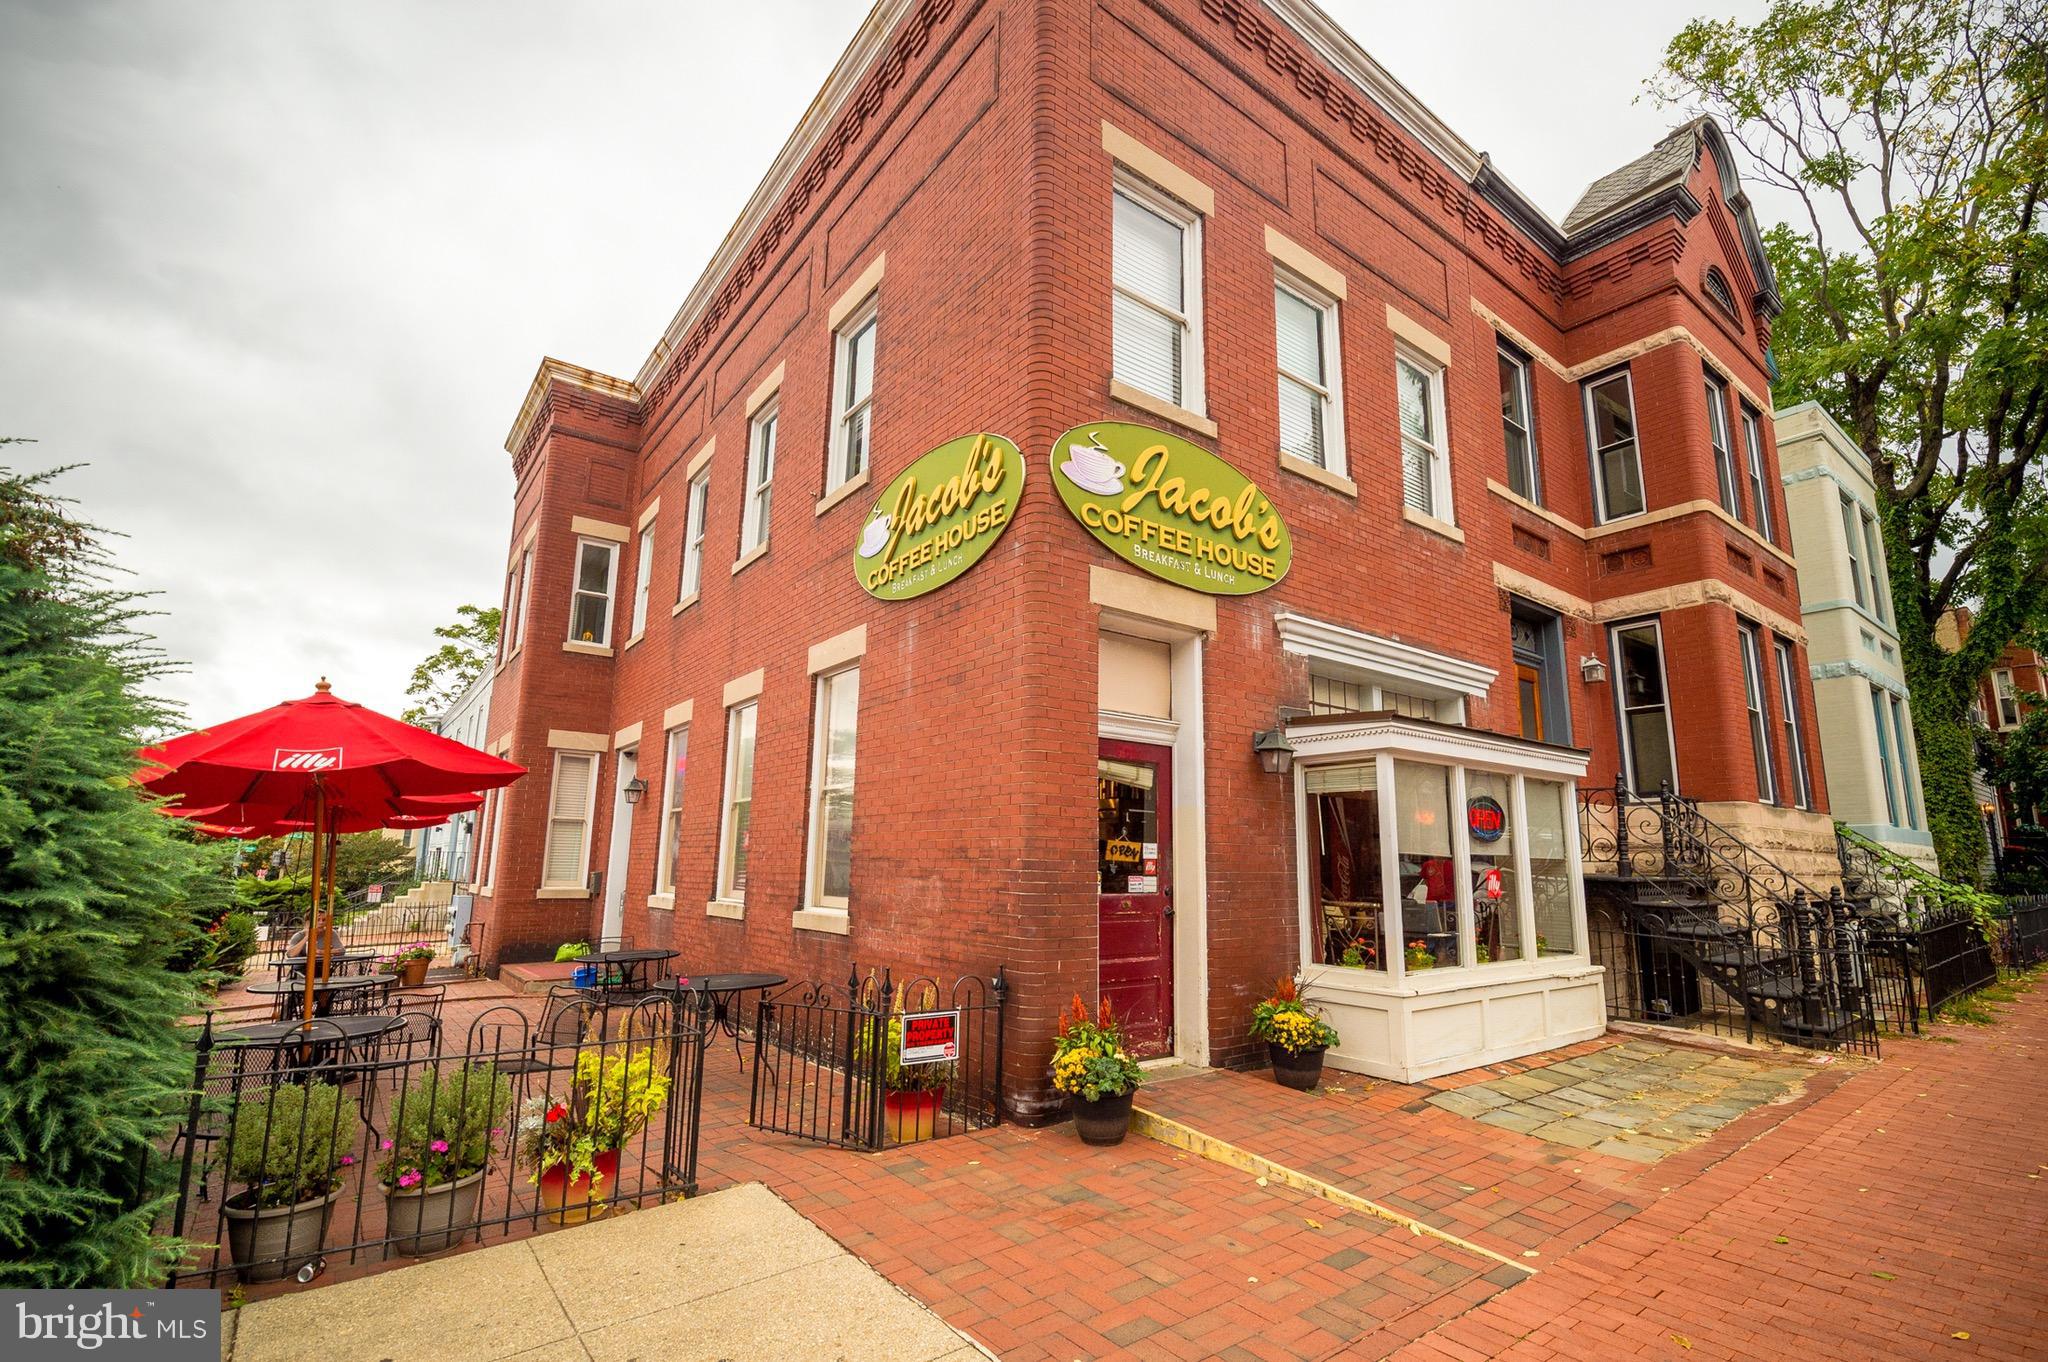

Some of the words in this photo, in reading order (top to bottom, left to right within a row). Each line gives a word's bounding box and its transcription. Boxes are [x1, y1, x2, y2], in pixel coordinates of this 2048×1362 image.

[884, 434, 1005, 563] Jacob's
[1121, 445, 1280, 550] Jacob's
[867, 540, 933, 589] COFFEE
[934, 498, 1007, 556] HOUSE
[1081, 503, 1192, 555] COFFEE
[1196, 536, 1277, 580] HOUSE
[891, 570, 928, 593] BREAKFAST
[930, 564, 936, 576] &
[938, 554, 963, 571] LUNCH
[1134, 544, 1190, 571] BREAKFAST
[1194, 562, 1201, 576] &
[1204, 568, 1235, 585] LUNCH
[279, 753, 336, 772] illy
[1469, 807, 1501, 831] OPEN
[906, 1027, 955, 1041] PROPERTY
[911, 1016, 949, 1030] PRIVATE
